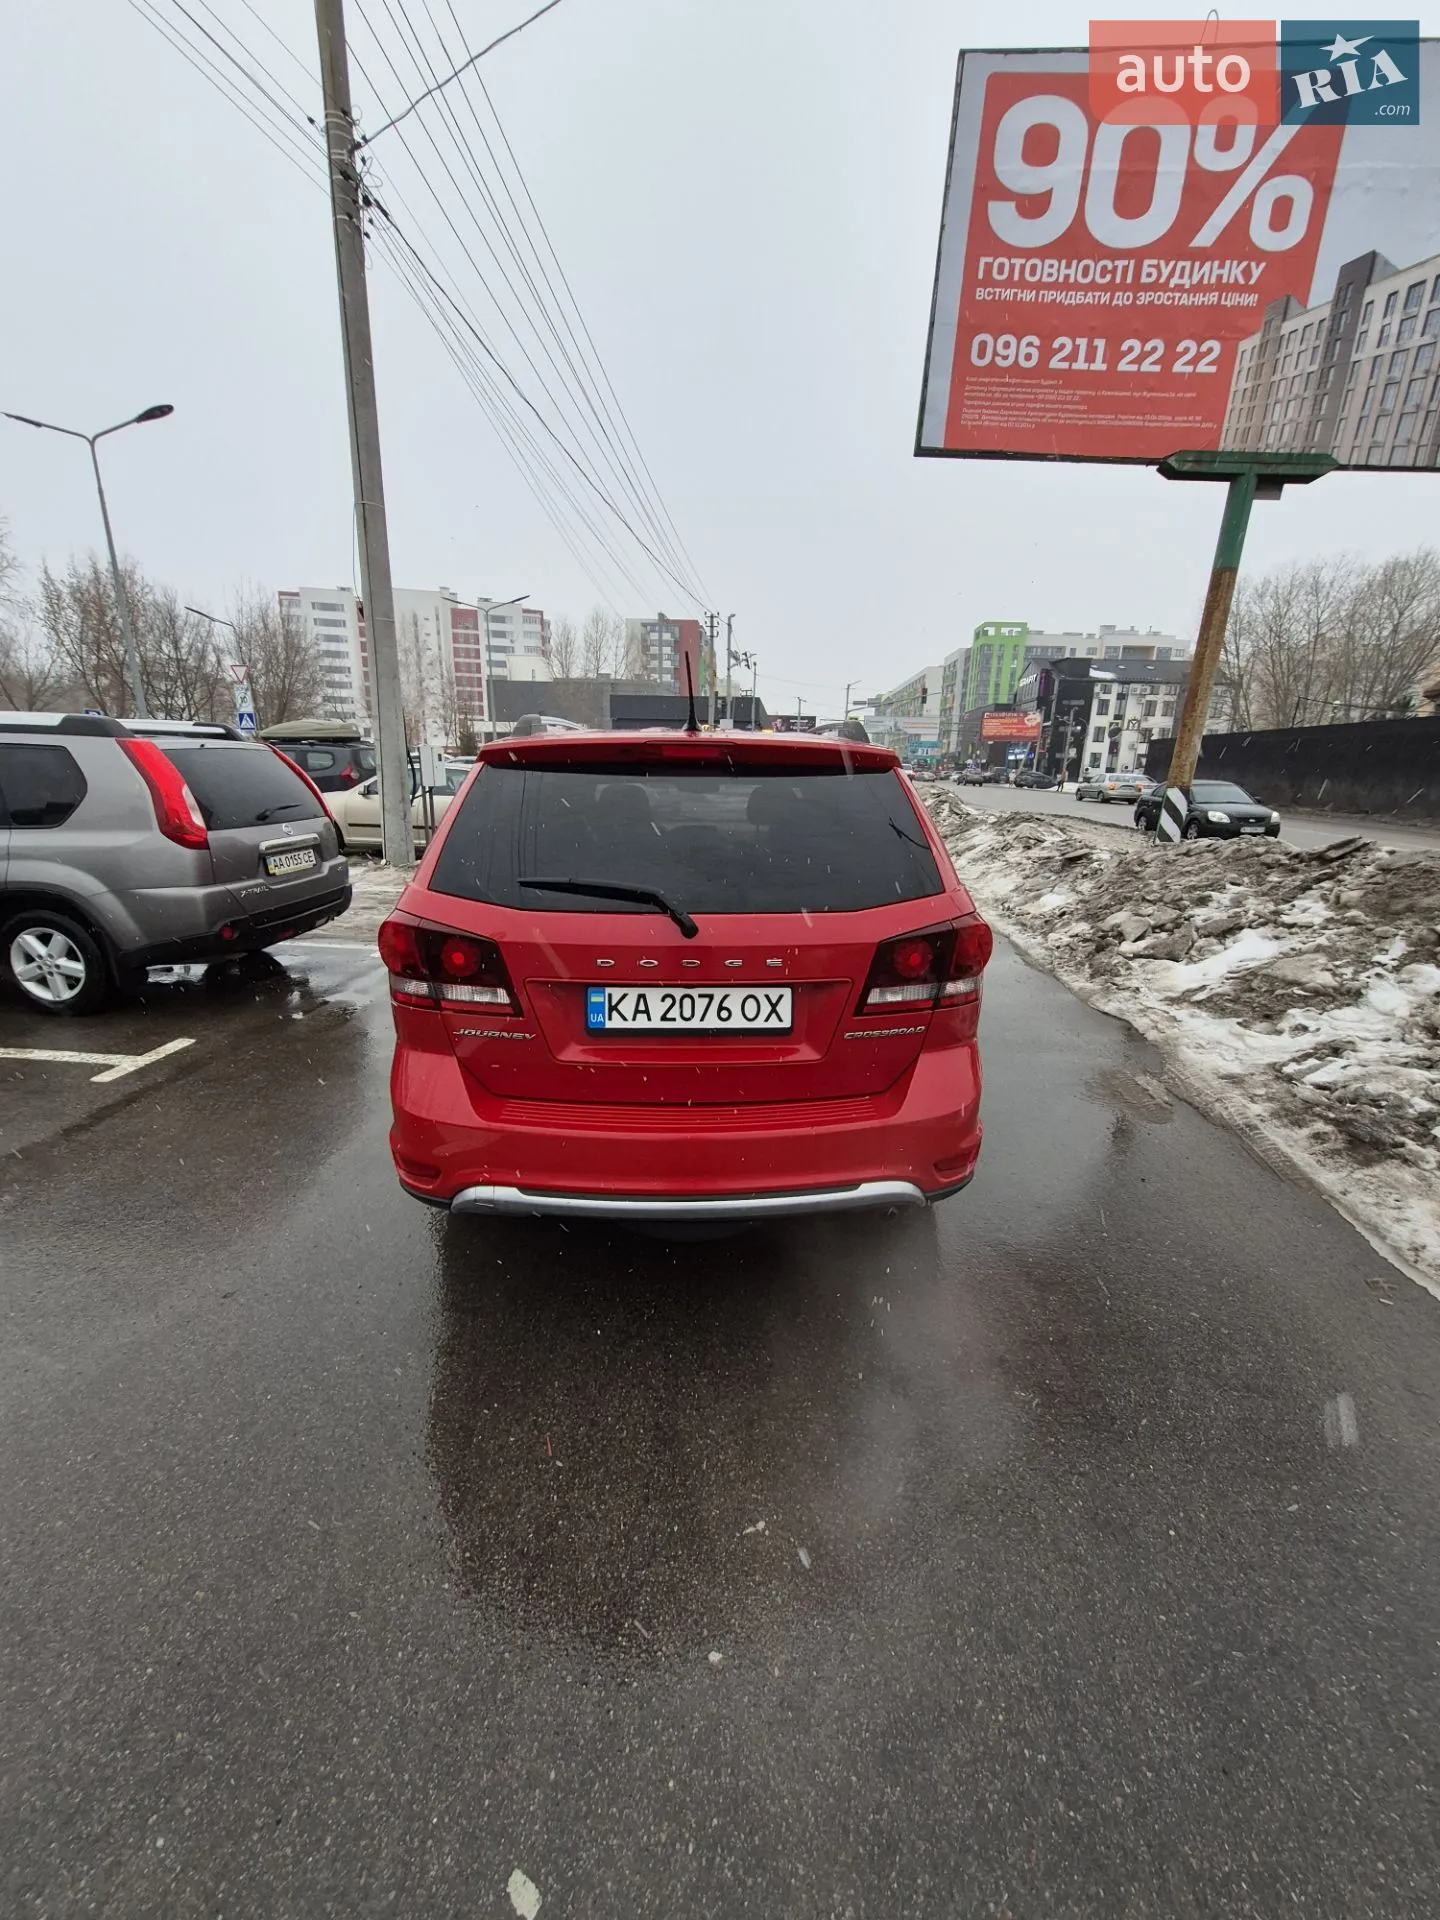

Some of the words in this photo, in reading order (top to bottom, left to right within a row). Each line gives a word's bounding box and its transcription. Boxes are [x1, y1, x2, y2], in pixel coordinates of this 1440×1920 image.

[987, 94, 1317, 252] 90%
[977, 256, 1135, 285] ГОТОВНОСТІ
[1139, 259, 1267, 289] БУДИНКУ
[975, 287, 1036, 302] ВСТИГНИ
[1038, 290, 1110, 306] ПРИДБАТИ
[1112, 292, 1133, 307] ДО
[1135, 292, 1219, 307] ЗРОСТАННЯ
[1220, 292, 1259, 307] ЦІНИ!
[970, 332, 1041, 369] 096
[1048, 335, 1108, 372] 211
[1116, 338, 1165, 373] 22
[1171, 338, 1222, 374] 22
[273, 856, 285, 870] AA
[285, 854, 302, 868] 0155
[302, 851, 314, 864] CE
[596, 958, 784, 968] DODGE
[607, 993, 652, 1022] KA
[659, 993, 733, 1023] 2076
[740, 993, 785, 1023] OX
[590, 1013, 605, 1023] UA
[452, 1028, 537, 1040] JOURNEY
[843, 1026, 926, 1040] CROSSROAD
